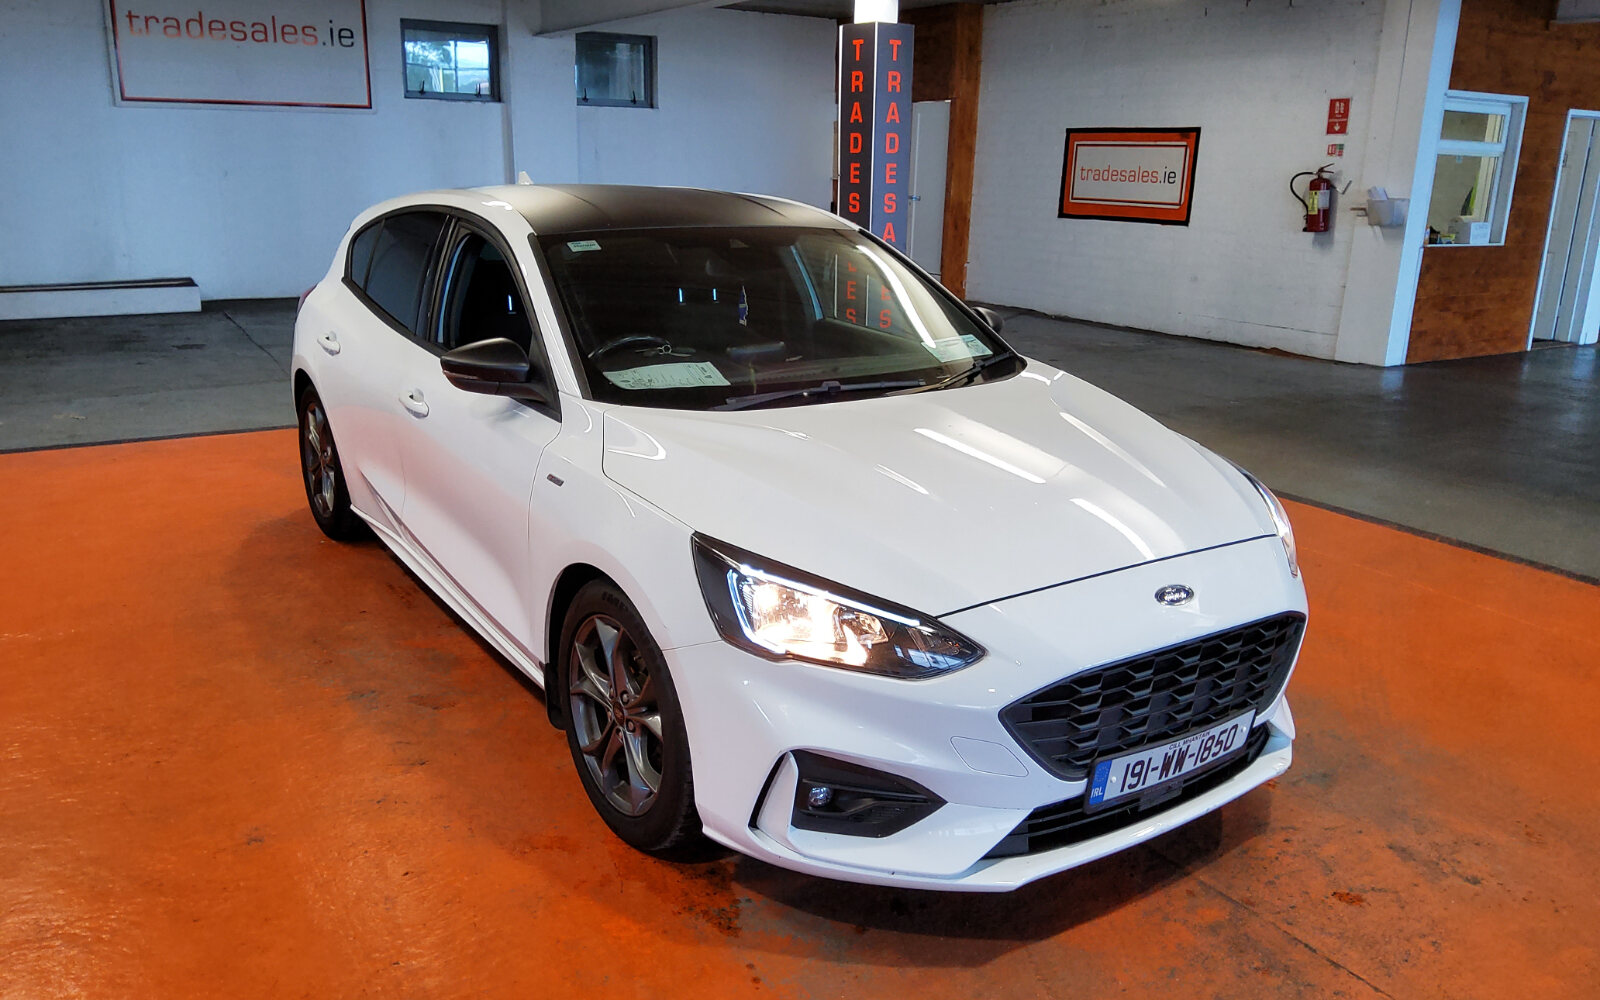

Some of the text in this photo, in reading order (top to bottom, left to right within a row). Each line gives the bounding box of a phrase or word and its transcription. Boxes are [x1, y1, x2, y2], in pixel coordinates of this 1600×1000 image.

[126, 10, 354, 48] tradesales.ie
[848, 39, 864, 225] TRADES
[1080, 165, 1177, 184] tradesales.ie
[1120, 723, 1239, 793] 191-WW-1850
[1090, 786, 1104, 799] IRL
